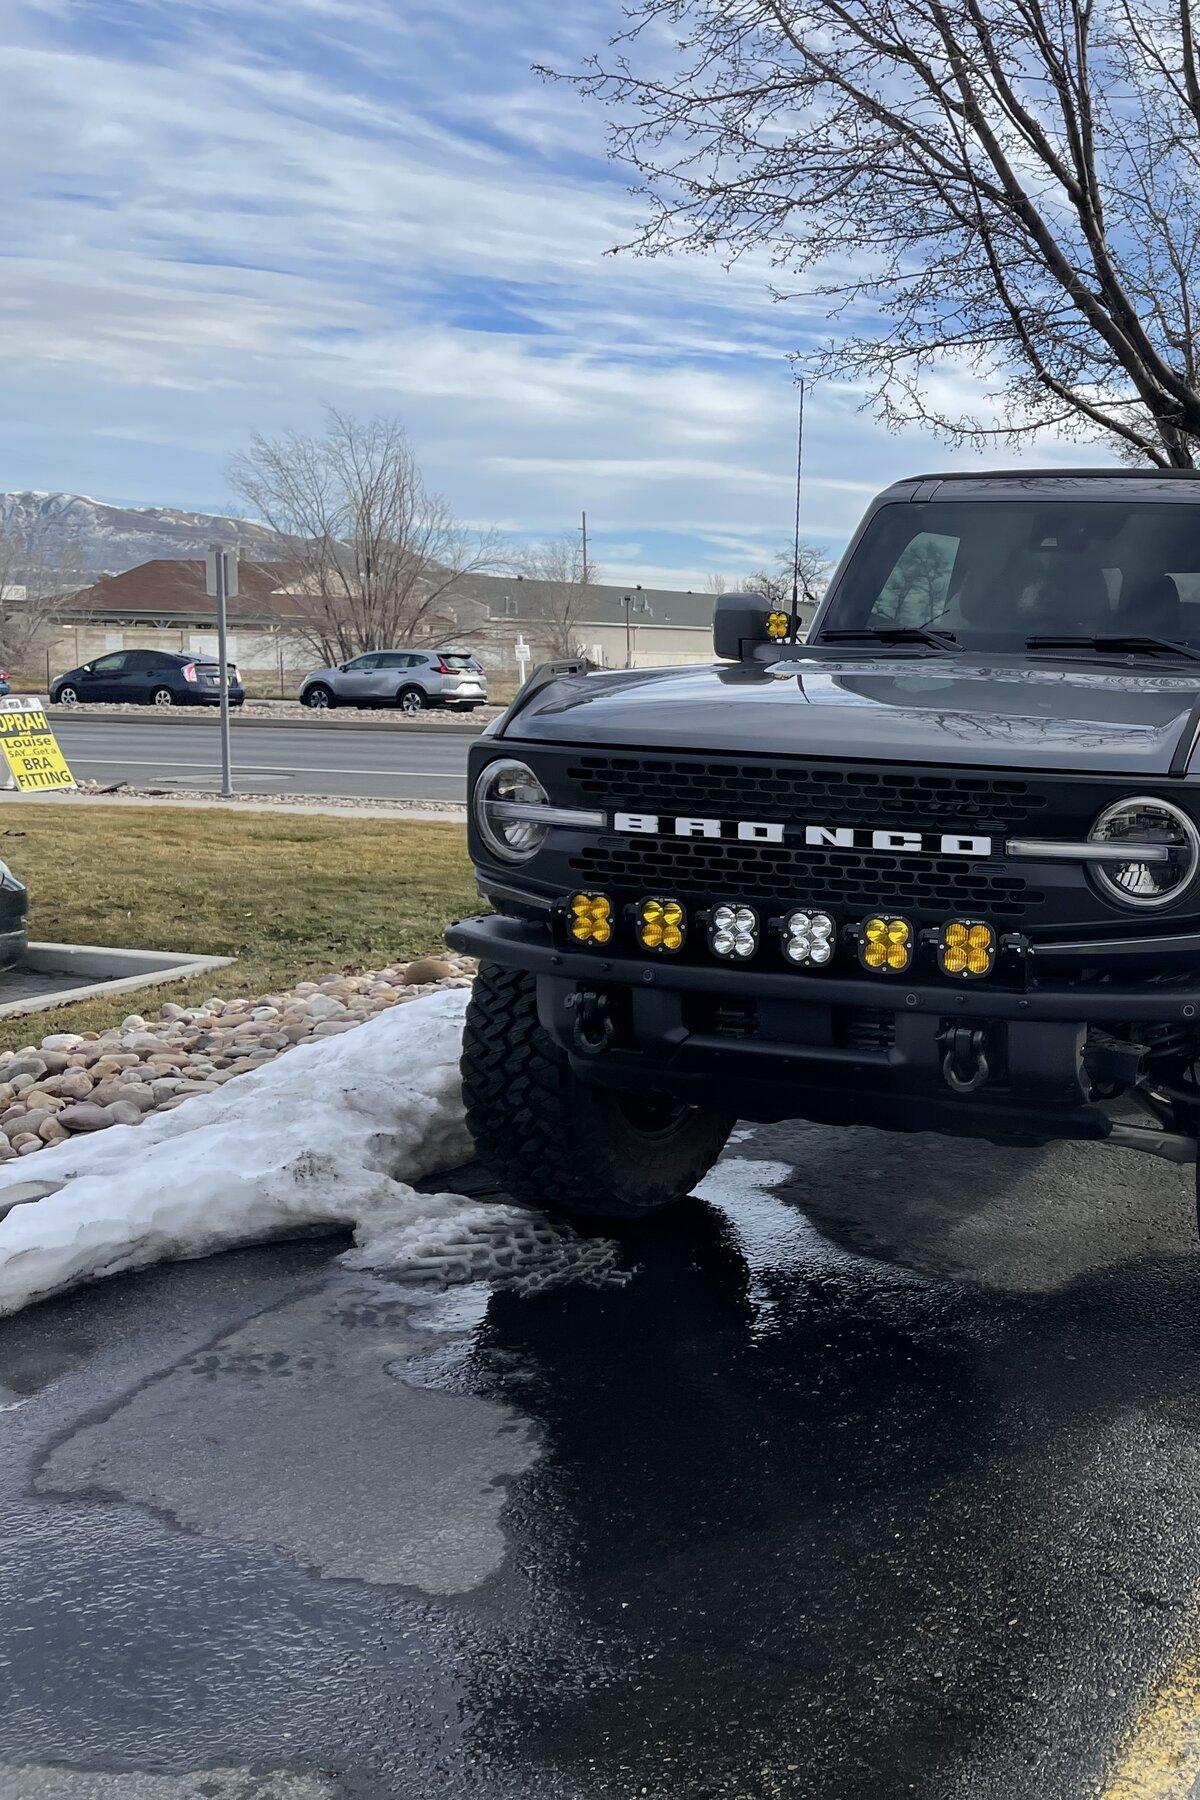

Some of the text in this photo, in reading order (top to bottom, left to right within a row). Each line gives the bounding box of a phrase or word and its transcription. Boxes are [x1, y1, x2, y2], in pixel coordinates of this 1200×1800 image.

[4, 736, 51, 748] Louise
[22, 757, 53, 770] BRA
[17, 771, 71, 787] FITTING
[614, 812, 992, 856] BRONCO
